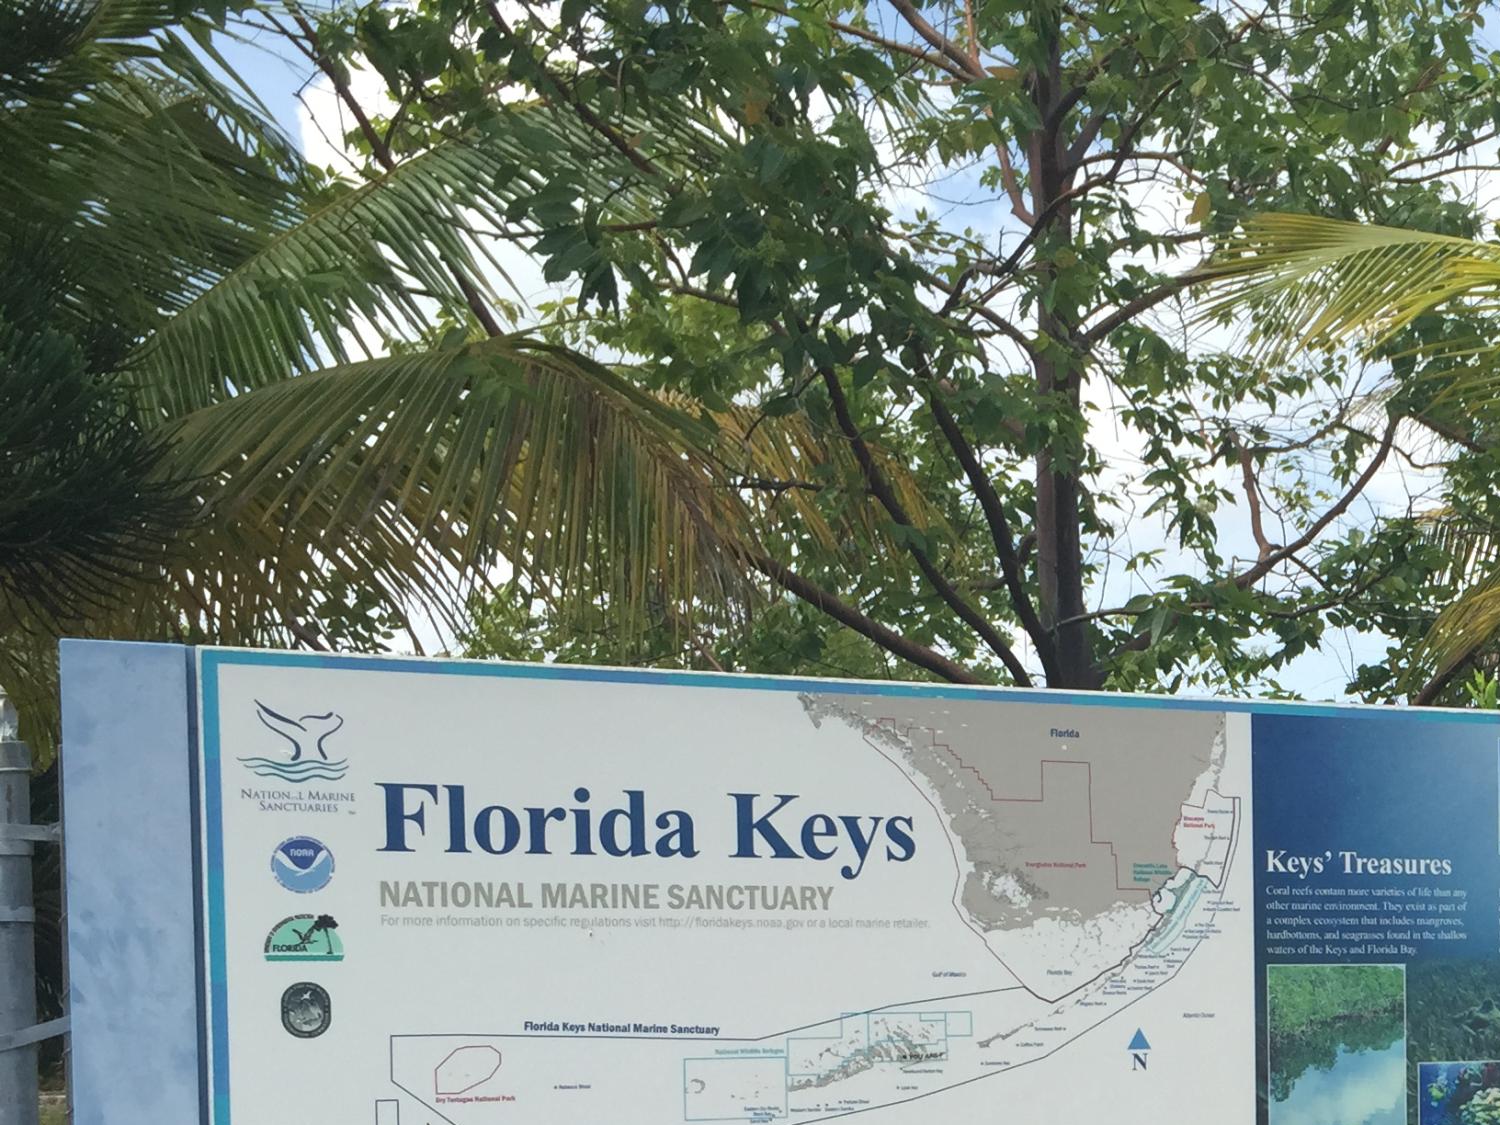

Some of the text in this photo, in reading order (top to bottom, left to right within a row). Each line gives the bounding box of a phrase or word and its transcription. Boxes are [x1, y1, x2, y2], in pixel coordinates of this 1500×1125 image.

[1050, 728, 1079, 738] Florida
[308, 790, 356, 802] MARINE
[259, 800, 339, 813] SANCTUARIES
[374, 782, 917, 880] Florida Keys
[1339, 851, 1452, 875] Treasures
[380, 880, 834, 910] NATIONAL MARINE SANCTUARY
[1265, 885, 1289, 895] Coral
[1292, 886, 1312, 895] reefs
[1314, 887, 1346, 896] contain
[1347, 888, 1369, 896] more
[1418, 887, 1432, 896] life
[1433, 887, 1451, 896] than
[1452, 890, 1466, 899] any
[1266, 900, 1289, 910] other
[1383, 901, 1402, 912] They
[1438, 903, 1455, 913] part
[380, 914, 399, 926] For
[402, 916, 433, 926] more
[436, 915, 502, 926] information
[523, 915, 566, 928] specific
[569, 917, 632, 930] regulations
[634, 917, 656, 927] visit
[828, 918, 853, 928] local
[855, 919, 890, 928] marine
[893, 918, 931, 928] retailer.
[1273, 915, 1311, 926] complex
[1361, 915, 1377, 924] that
[1379, 915, 1414, 925] includes
[1416, 917, 1465, 927] mangroves,
[1323, 930, 1339, 939] and
[1386, 930, 1410, 939] found
[1422, 931, 1435, 939] the
[1266, 946, 1295, 954] waters
[1309, 944, 1322, 953] the
[1325, 944, 1347, 956] Keys
[1349, 944, 1365, 953] and
[1367, 944, 1397, 953] Florida
[1400, 944, 1418, 955] Bay.
[524, 1020, 720, 1036] Florida Keys National Marine Sanctuary
[1132, 1053, 1147, 1070] N
